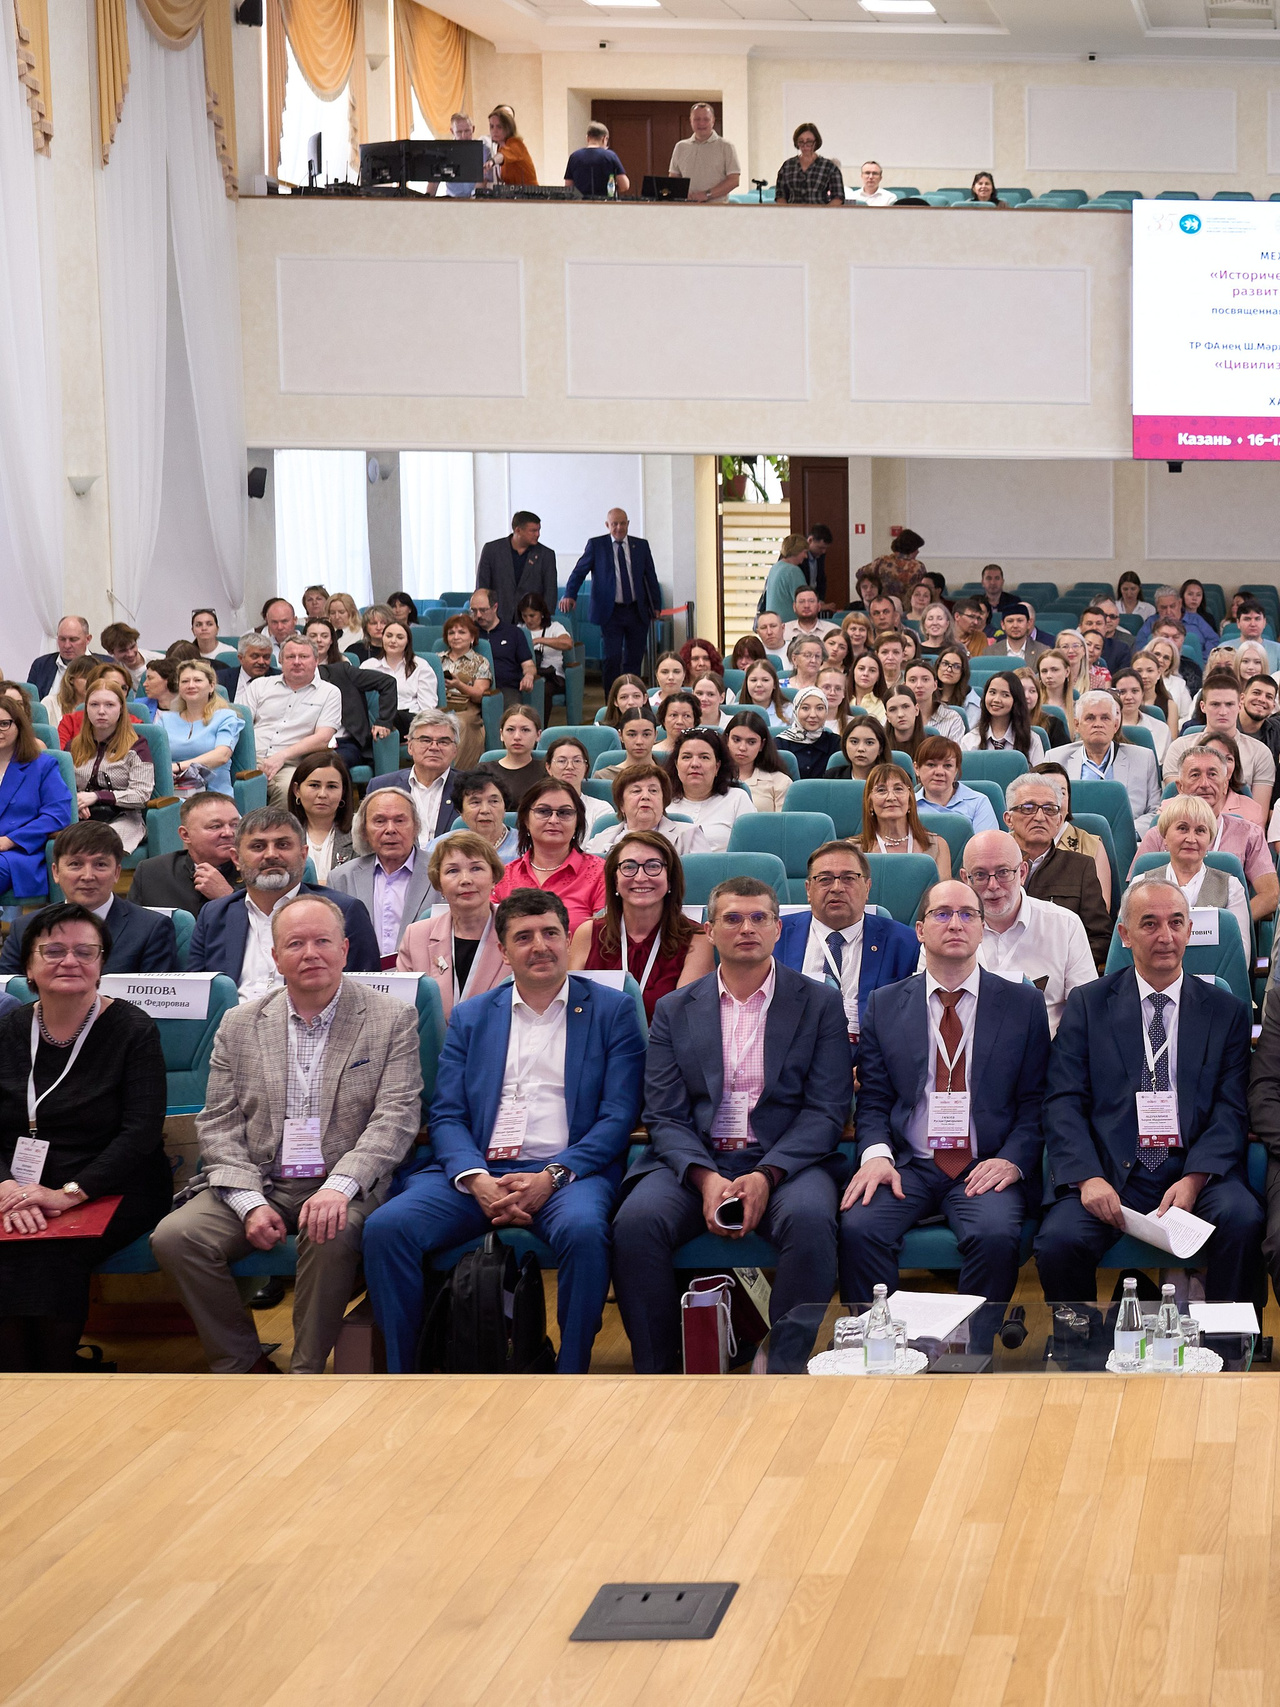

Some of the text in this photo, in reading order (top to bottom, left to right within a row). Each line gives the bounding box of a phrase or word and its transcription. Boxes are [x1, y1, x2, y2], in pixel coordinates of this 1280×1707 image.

[1189, 341, 1202, 350] ТР
[1177, 432, 1232, 446] Казань
[127, 985, 177, 996] ПОПОВА
[144, 999, 190, 1009] Федоровна
